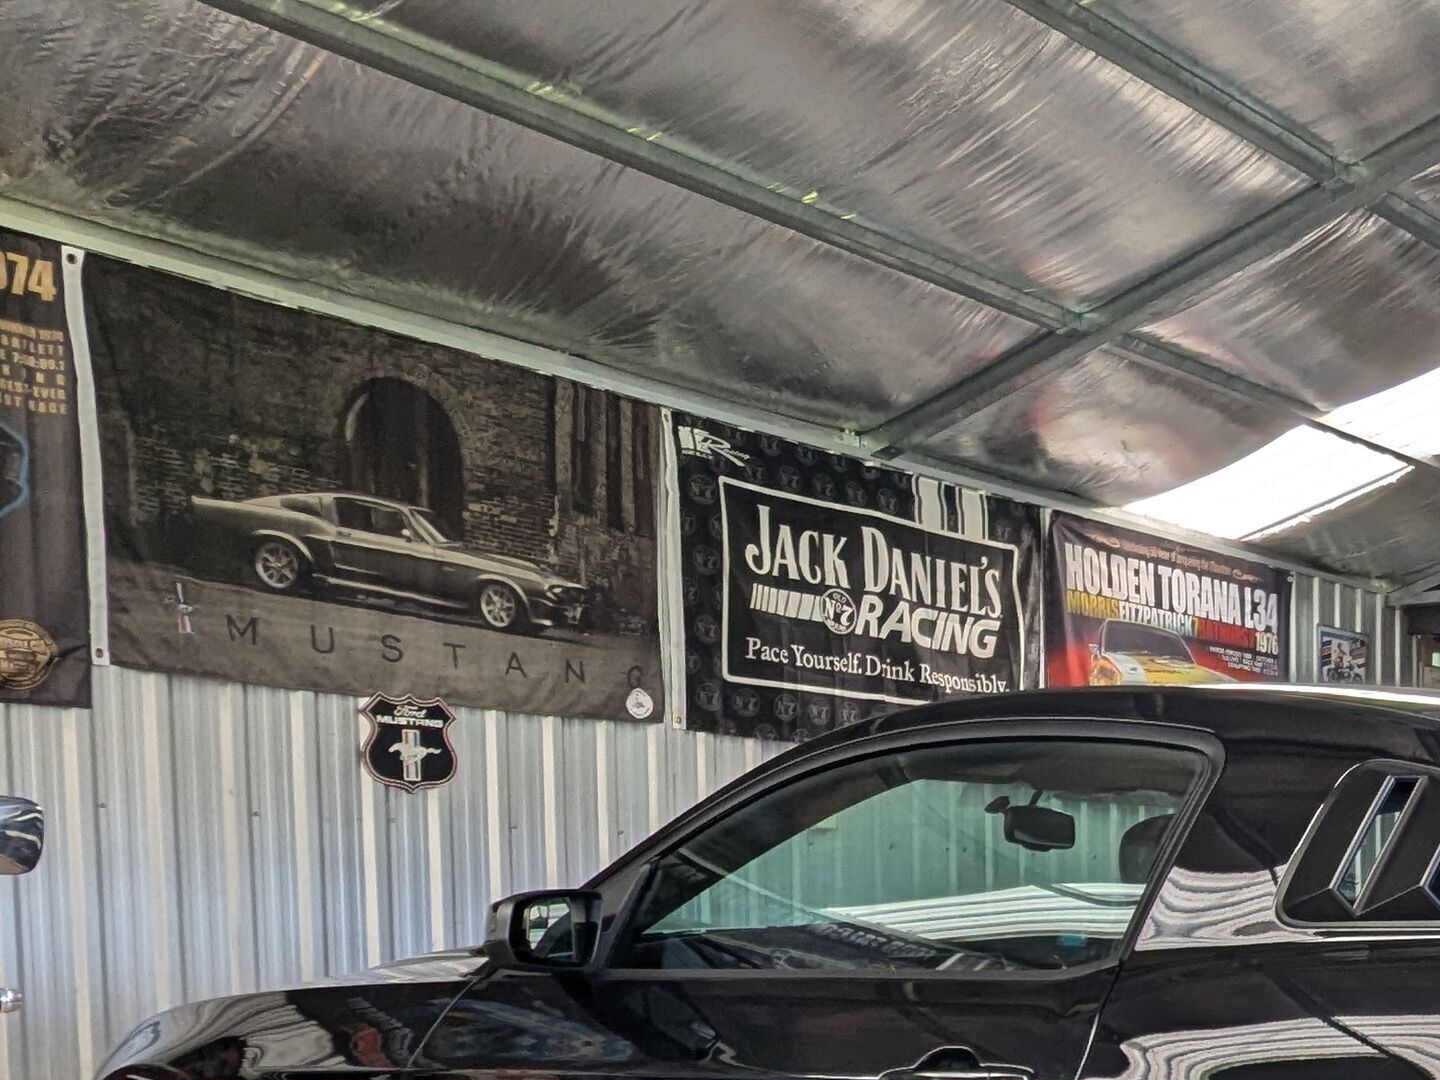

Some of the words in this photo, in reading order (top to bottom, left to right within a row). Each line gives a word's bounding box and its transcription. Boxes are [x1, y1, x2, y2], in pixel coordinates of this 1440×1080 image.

[745, 504, 850, 590] JACK
[861, 526, 1003, 619] DANIEL'S
[1064, 543, 1154, 606] HOLDEN
[1158, 564, 1241, 626] TORANA
[1244, 587, 1279, 632] L34
[226, 613, 644, 688] MUSTANG
[855, 595, 1001, 659] RACING
[1255, 632, 1279, 655] 1976
[745, 637, 789, 664] Pace
[790, 644, 863, 674] Yourself.
[864, 655, 915, 682] Drink
[920, 664, 1009, 694] Responsibly.
[376, 714, 444, 728] MUSTANG
[393, 704, 427, 718] Ford
